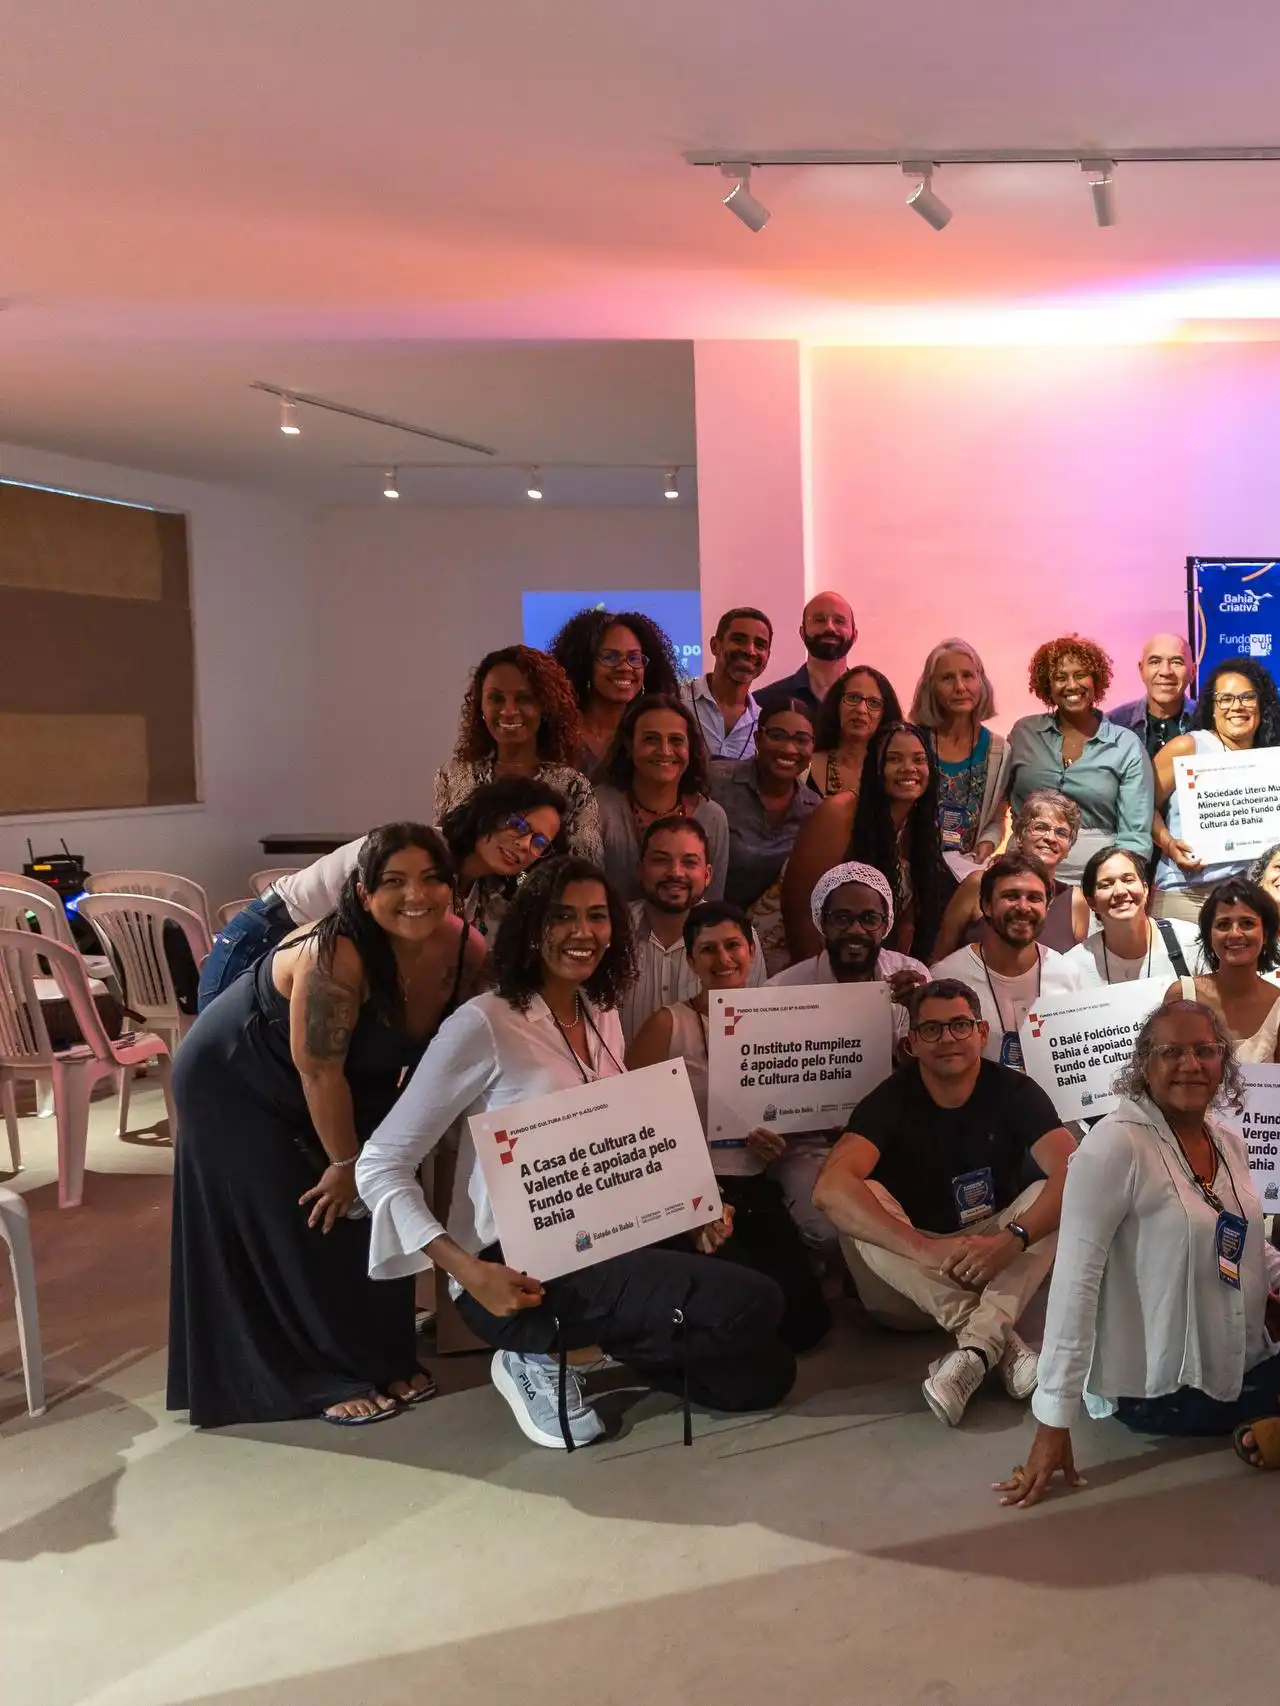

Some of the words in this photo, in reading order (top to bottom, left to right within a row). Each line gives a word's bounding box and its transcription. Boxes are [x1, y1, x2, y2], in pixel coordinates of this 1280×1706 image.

[1224, 593, 1252, 603] Bahia
[1219, 602, 1258, 612] Criativa
[1219, 634, 1250, 644] Fundo
[1238, 643, 1250, 653] de
[1197, 792, 1203, 800] A
[1204, 787, 1243, 799] Sociedade
[1198, 799, 1230, 810] Minerva
[1232, 796, 1279, 807] Cachoeirana
[1199, 809, 1231, 820] apoiada
[1232, 807, 1249, 819] pelo
[1251, 805, 1275, 815] Fundo
[1200, 819, 1228, 830] Cultura
[1230, 818, 1240, 827] da
[1241, 816, 1263, 826] Bahia
[1049, 1037, 1058, 1048] O
[1060, 1031, 1083, 1046] Balé
[1084, 1025, 1130, 1041] Folclórico
[741, 1044, 751, 1055] O
[753, 1040, 802, 1055] Instituto
[805, 1038, 861, 1052] Rumpilezz
[1051, 1045, 1081, 1061] Bahia
[1083, 1044, 1090, 1054] é
[1092, 1037, 1133, 1054] apoiado
[740, 1060, 748, 1071] é
[751, 1055, 798, 1072] apoiado
[801, 1054, 826, 1068] pelo
[828, 1052, 863, 1065] Fundo
[1054, 1060, 1086, 1074] Fundo
[1088, 1056, 1101, 1067] de
[740, 1074, 755, 1087] de
[758, 1071, 800, 1086] Cultura
[802, 1070, 817, 1082] da
[820, 1067, 852, 1081] Bahia
[1056, 1072, 1087, 1087] Bahia
[1242, 1112, 1251, 1123] A
[520, 1163, 531, 1178] A
[533, 1155, 567, 1175] Casa
[569, 1147, 587, 1163] de
[589, 1132, 636, 1157] Cultura
[638, 1125, 656, 1143] de
[1247, 1144, 1278, 1155] undo
[523, 1169, 580, 1195] Valente
[581, 1162, 590, 1177] é
[593, 1148, 647, 1175] apoiada
[648, 1137, 677, 1159] pelo
[1249, 1159, 1275, 1171] ahia
[528, 1190, 574, 1213] Fundo
[576, 1182, 594, 1198] de
[595, 1168, 644, 1192] Cultura
[646, 1160, 663, 1176] da
[533, 1208, 576, 1231] Bahia
[519, 1372, 537, 1400] FILA
